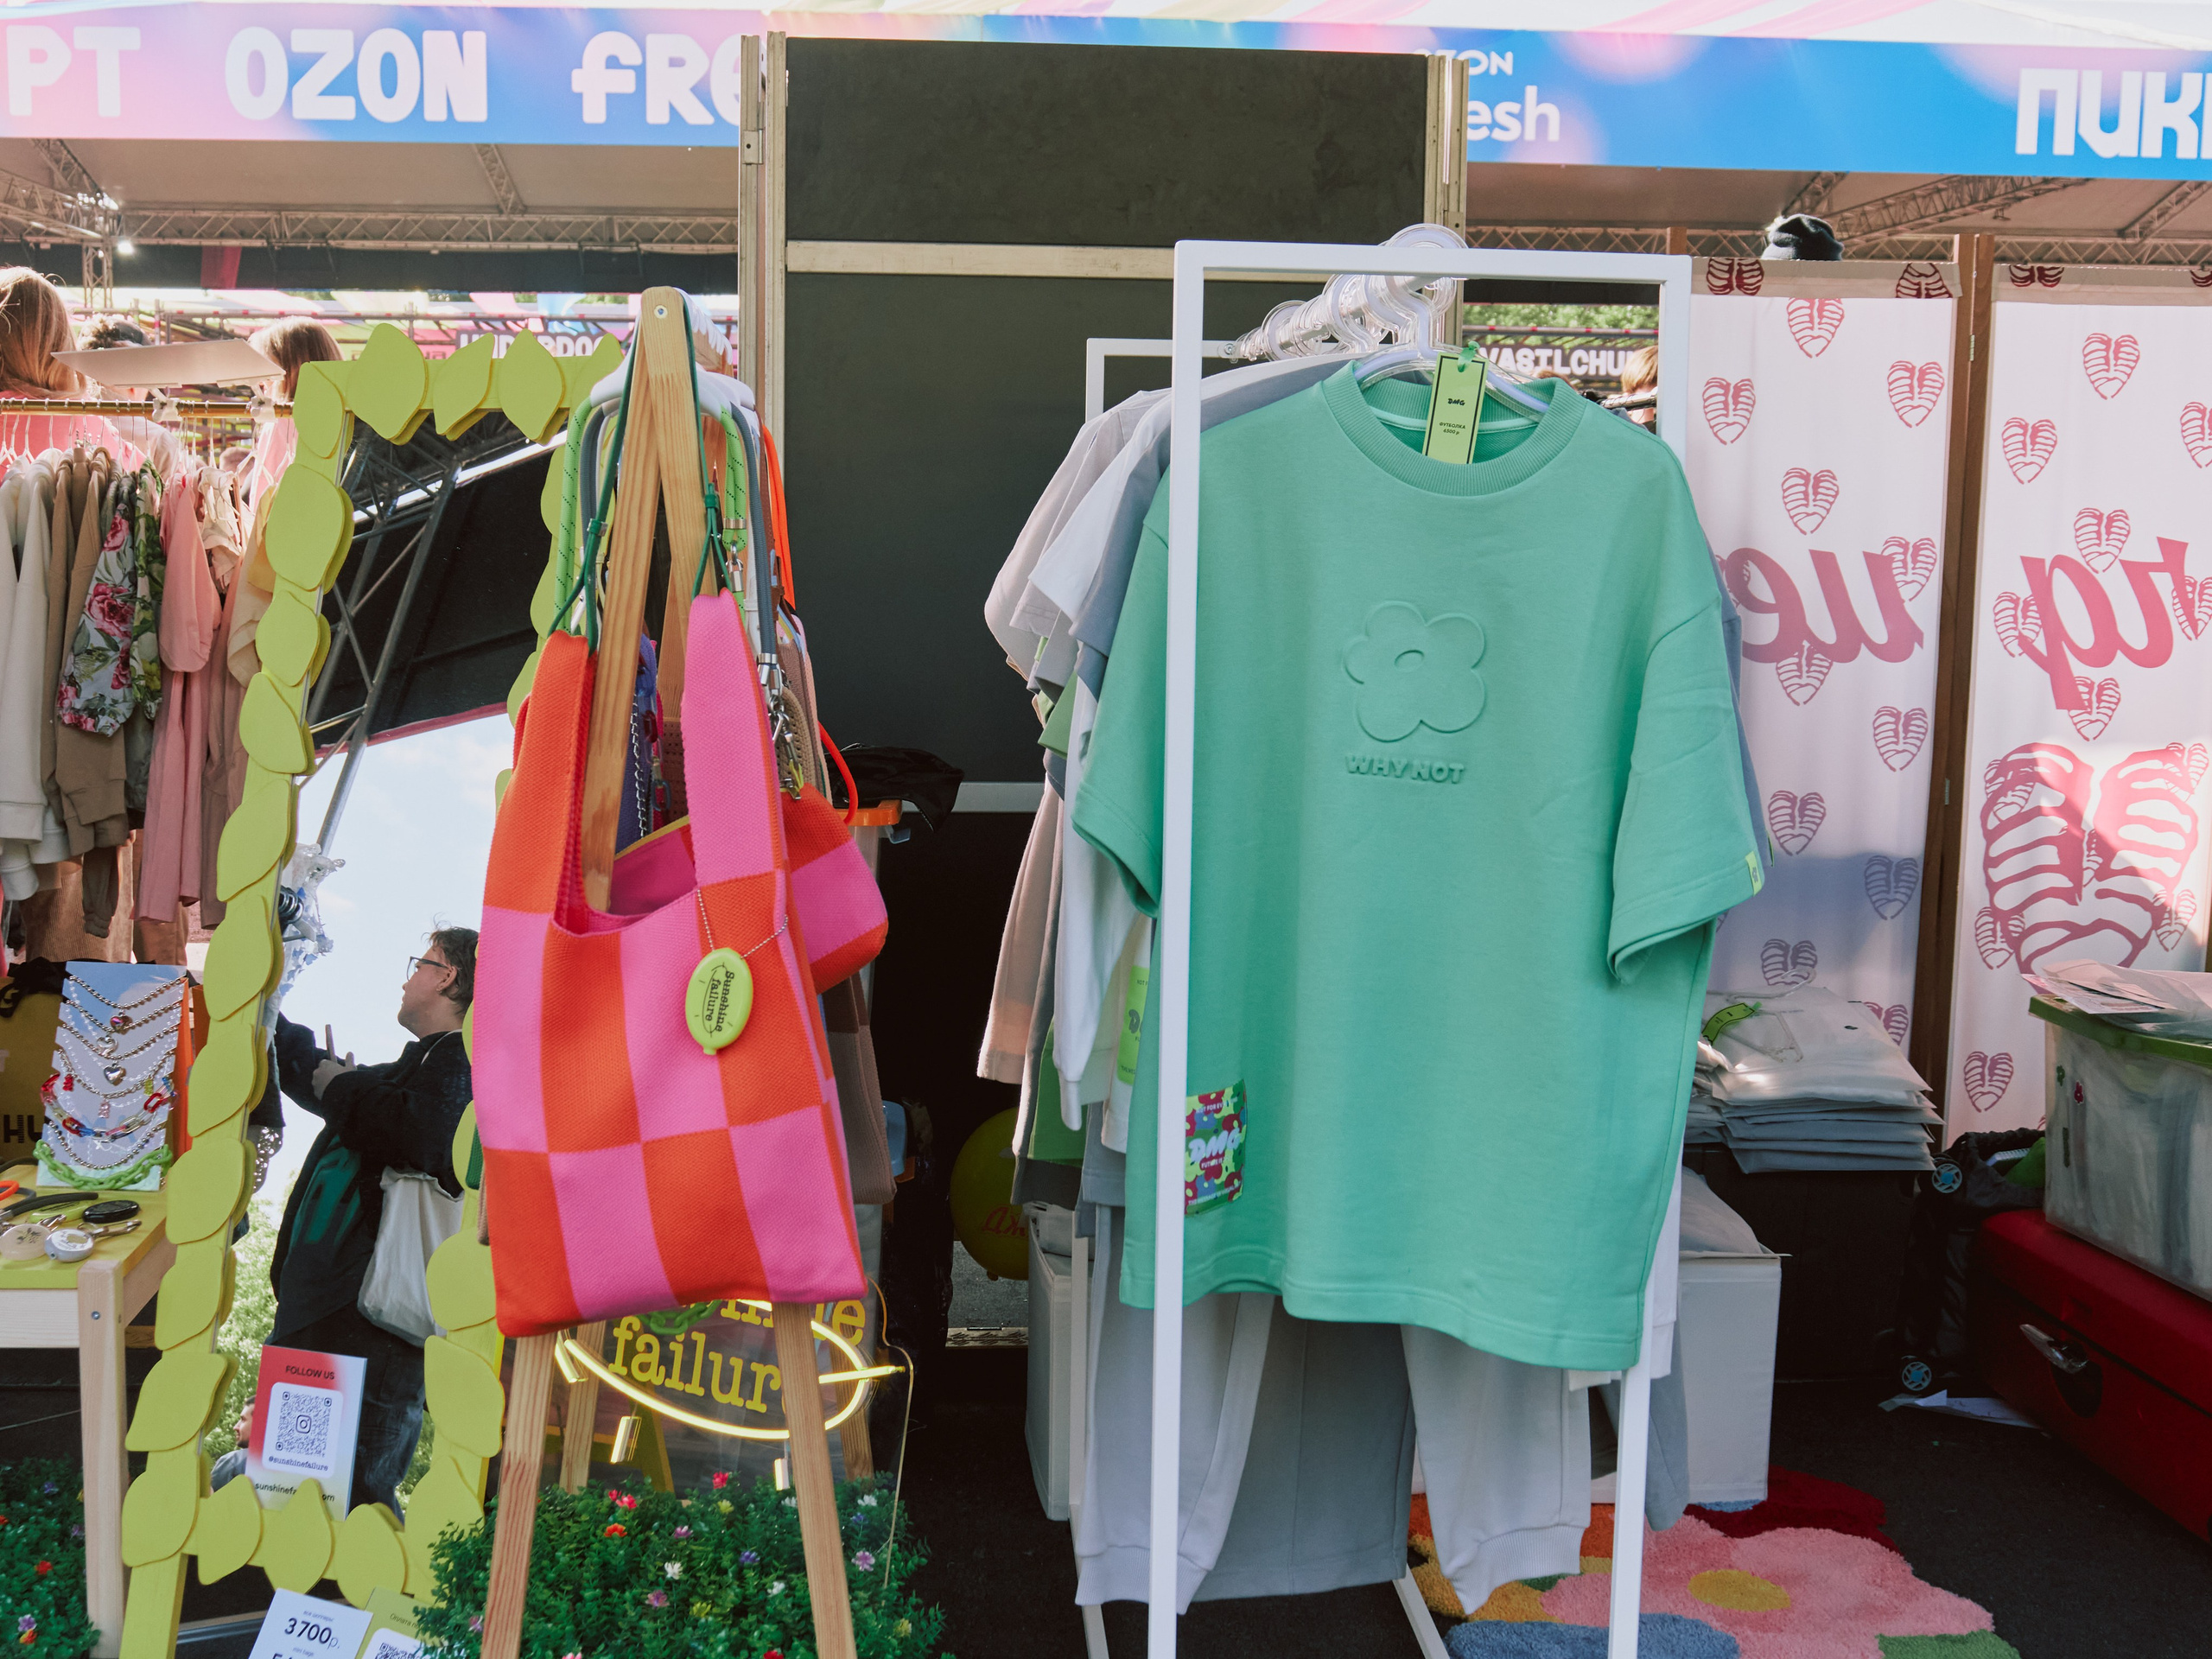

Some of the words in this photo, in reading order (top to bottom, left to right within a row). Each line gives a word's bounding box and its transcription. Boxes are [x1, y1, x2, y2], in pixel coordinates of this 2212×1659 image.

[225, 27, 488, 123] OZON
[1447, 397, 1465, 406] DMG
[704, 977, 722, 1022] failure
[715, 970, 735, 1033] Sunshine
[1188, 1128, 1242, 1163] DMG
[285, 1365, 322, 1378] FOLLOW
[323, 1371, 335, 1380] US
[607, 1316, 785, 1414] failur
[268, 1456, 328, 1471] @sunshinefailure
